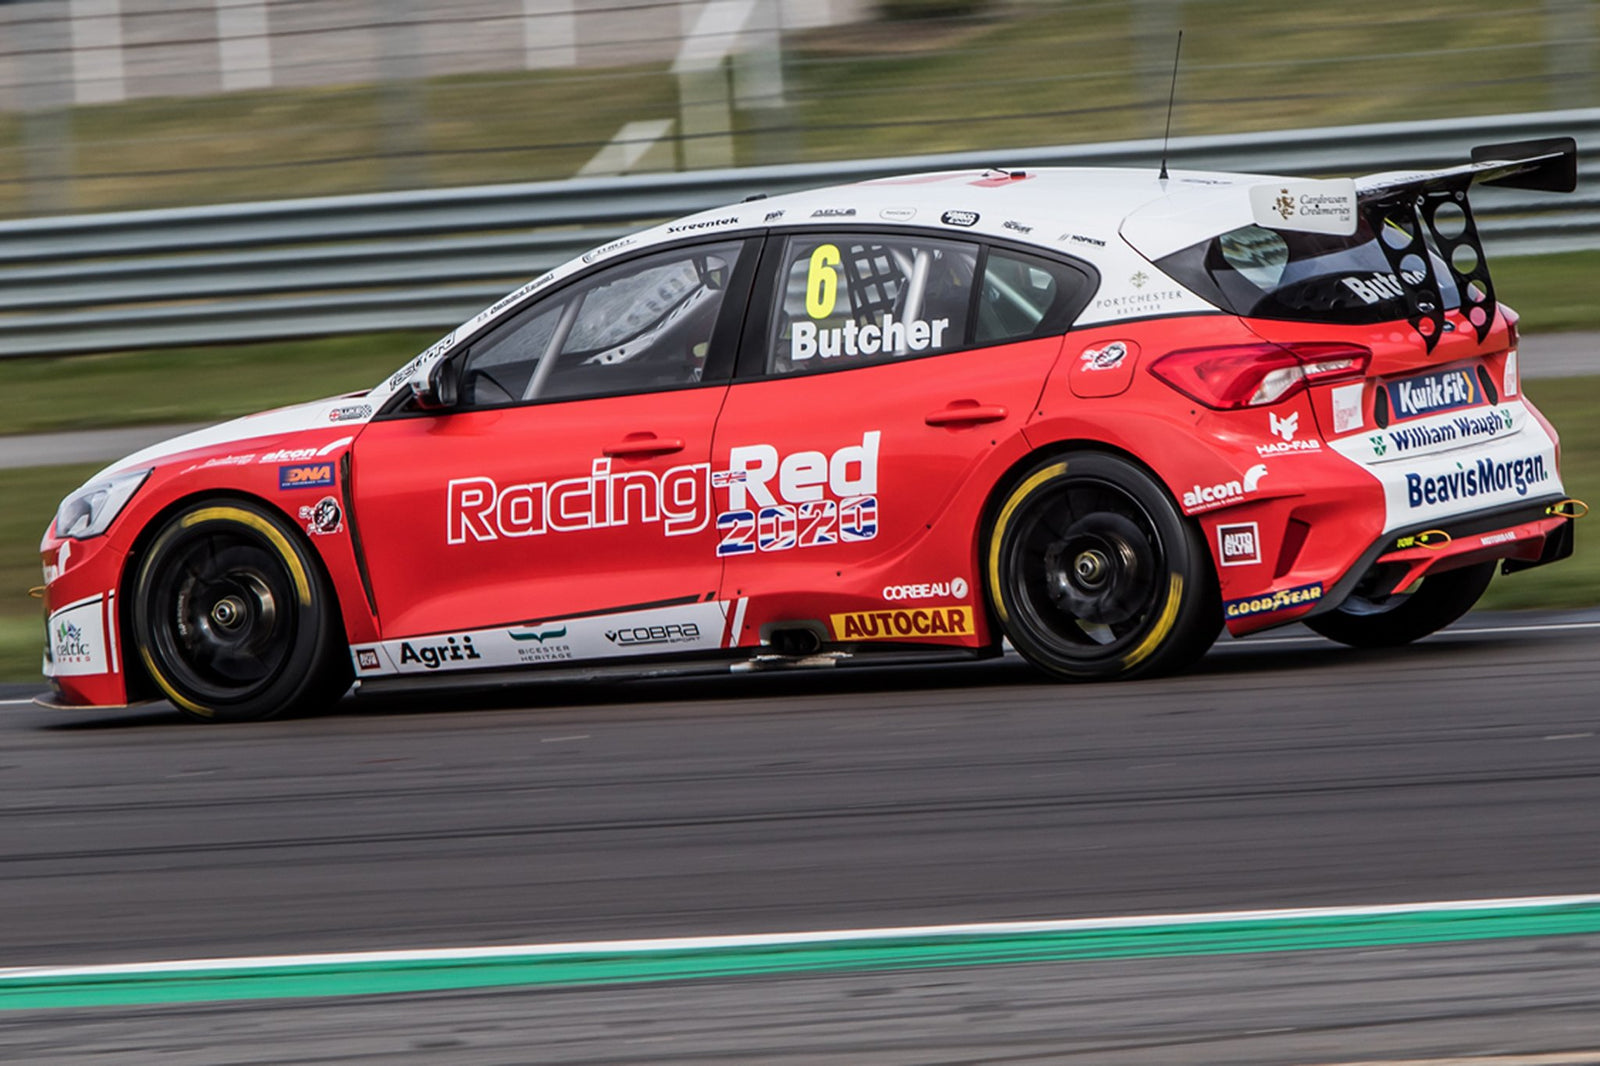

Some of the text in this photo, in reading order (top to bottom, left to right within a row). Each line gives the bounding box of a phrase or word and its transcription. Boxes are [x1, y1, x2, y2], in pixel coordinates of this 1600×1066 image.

[1300, 205, 1350, 216] Creameries
[805, 244, 841, 319] 6
[1096, 290, 1183, 309] PORTCHESTER
[791, 313, 949, 361] Butcher
[1389, 411, 1503, 452] William Waugh
[262, 448, 318, 462] alcon
[1256, 439, 1320, 455] HAD-FAB
[285, 465, 331, 482] DNA
[446, 430, 881, 545] Racing Red
[1183, 480, 1243, 507] alcon
[715, 496, 878, 557] 2020
[882, 582, 950, 600] CORBEAU
[1227, 586, 1322, 617] GOODYEAR
[618, 623, 700, 642] COBRA
[844, 608, 966, 638] AUTOCAR
[56, 643, 90, 656] celtic
[400, 636, 481, 669] Agrii
[517, 645, 570, 655] BICESTER
[520, 652, 572, 662] HERITAGE
